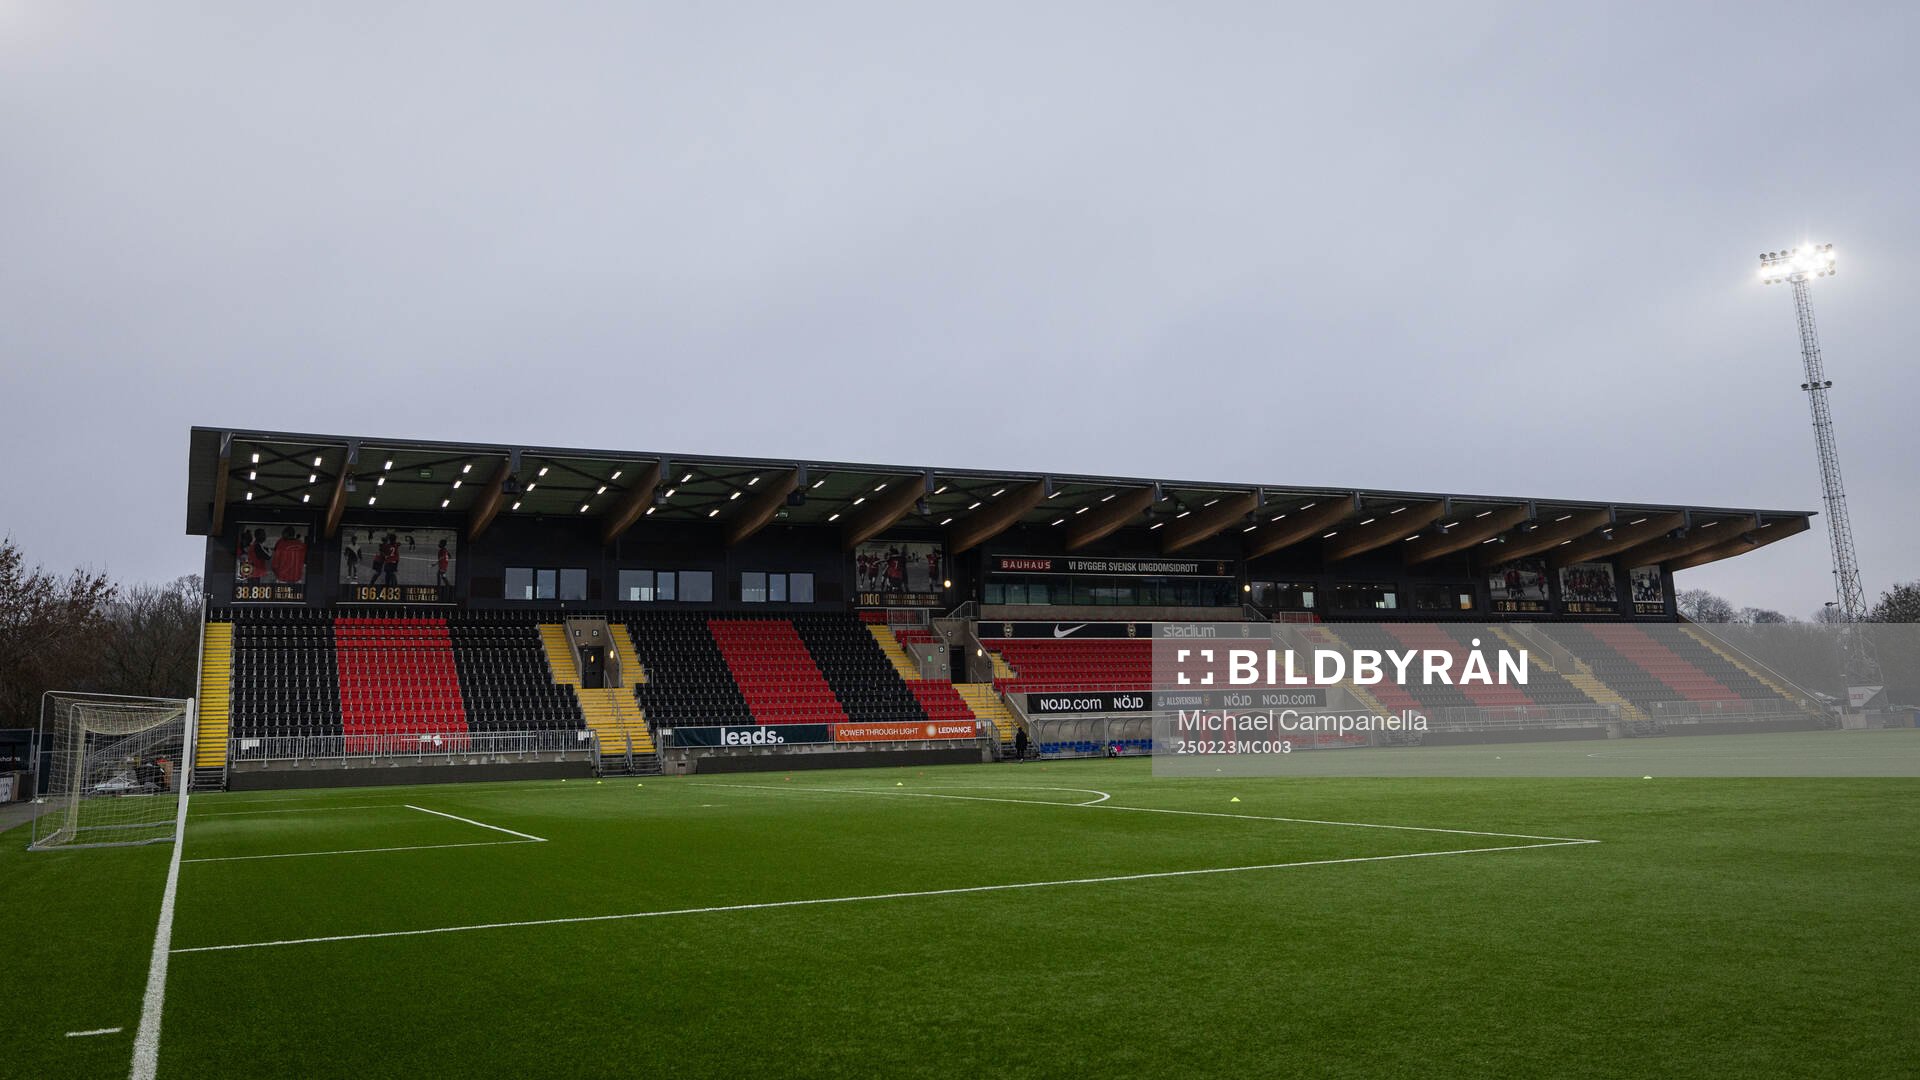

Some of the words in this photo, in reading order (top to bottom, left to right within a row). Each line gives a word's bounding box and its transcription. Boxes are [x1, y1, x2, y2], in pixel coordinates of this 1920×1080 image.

[1002, 561, 1051, 569] BAUHAUS
[1068, 561, 1076, 570] VI
[1078, 561, 1107, 571] BYGGER
[1108, 562, 1136, 571] SVENSK
[1138, 562, 1198, 572] UNGDOMSIDROTT
[236, 586, 272, 599] 38.880
[356, 587, 400, 600] 196.483
[860, 593, 880, 605] 1000
[1163, 624, 1216, 638] stadium
[1040, 698, 1102, 710] NOJD.com
[1113, 694, 1144, 709] NÖJD
[1166, 696, 1203, 706] ALLSVENSKAN
[1223, 692, 1252, 707] NÖJD
[1262, 694, 1316, 706] NOJD.com
[840, 728, 865, 737] POWER
[866, 728, 899, 736] THROUGH
[900, 727, 919, 736] LIGHT
[938, 726, 972, 734] LEDVANCE
